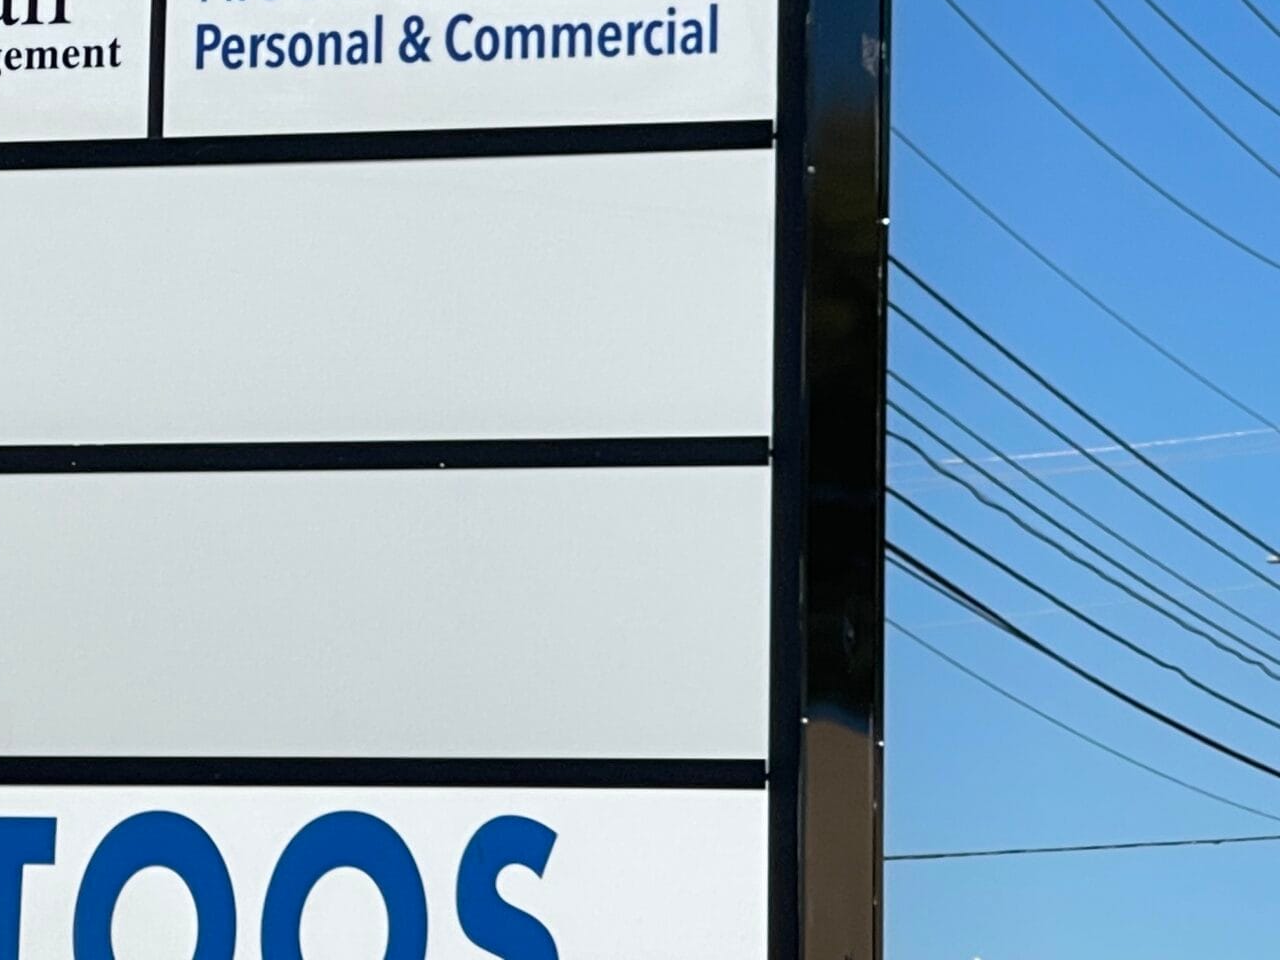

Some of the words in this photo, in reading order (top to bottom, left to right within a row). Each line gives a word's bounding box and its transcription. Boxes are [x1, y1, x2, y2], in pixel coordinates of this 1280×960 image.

[195, 14, 384, 70] Personal
[398, 15, 432, 64] &
[444, 4, 719, 62] Commercial
